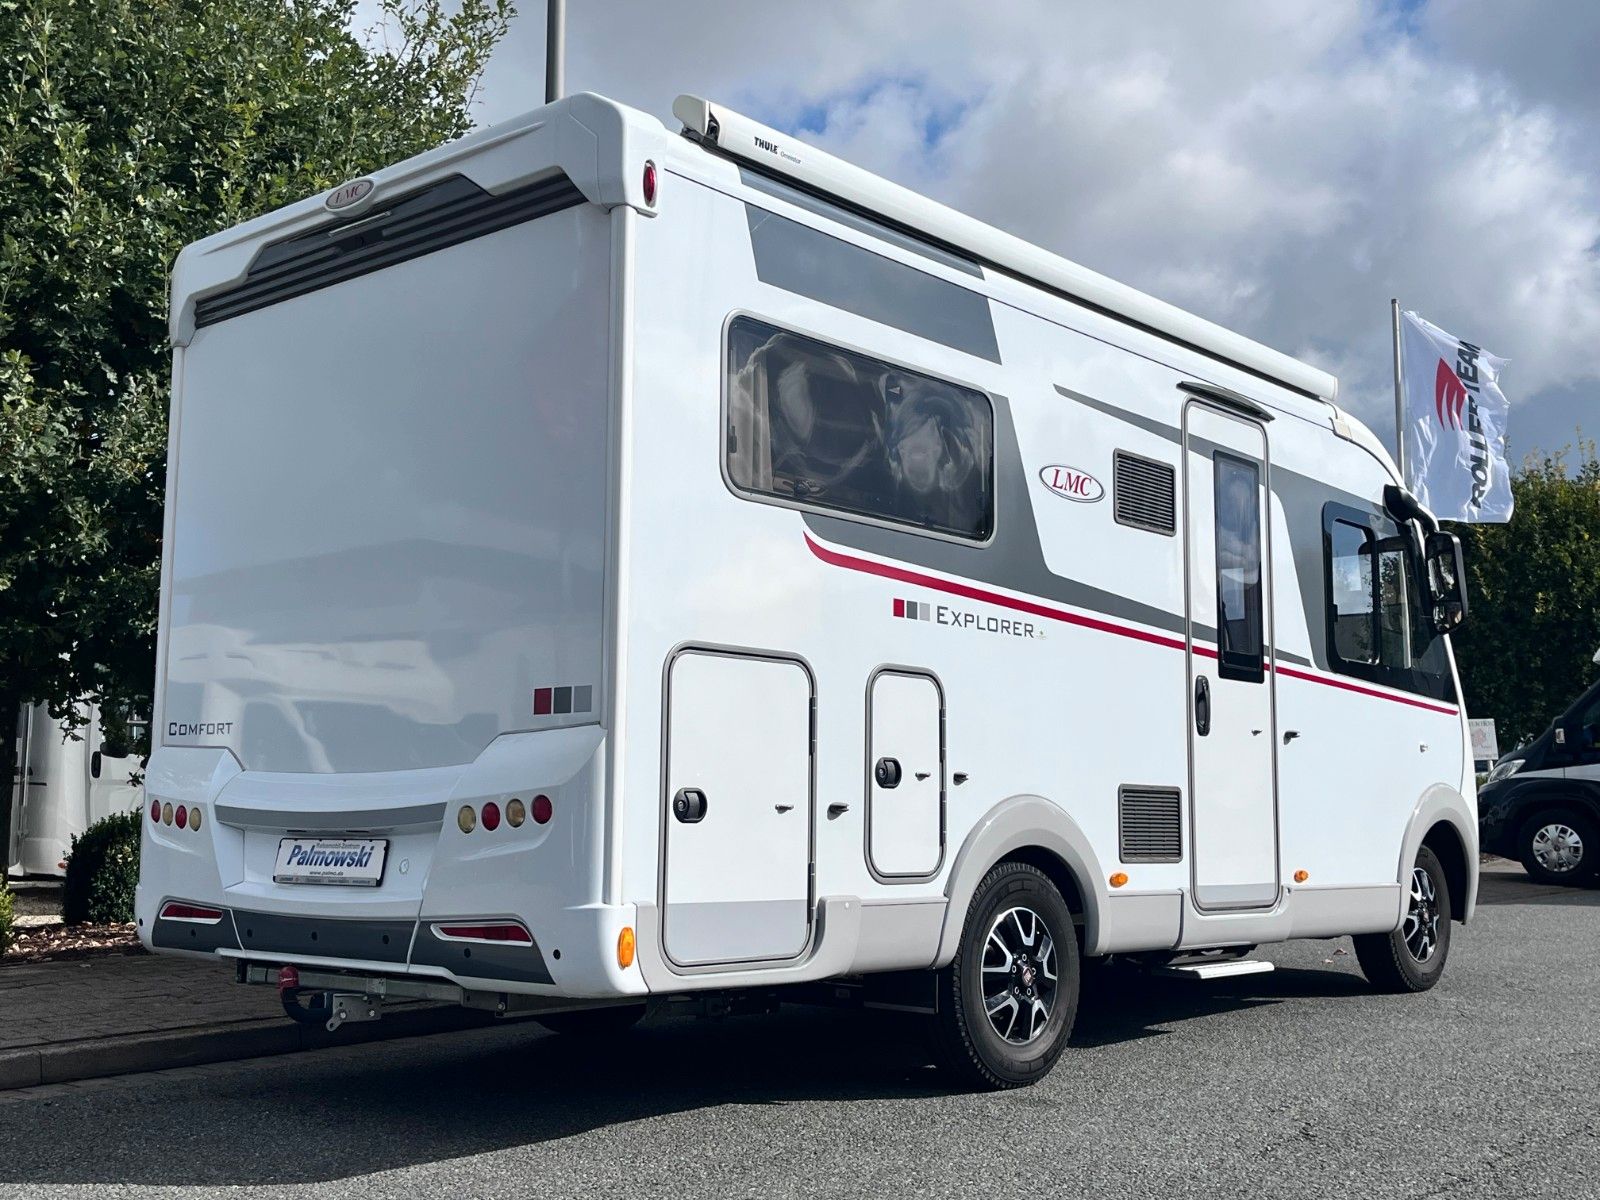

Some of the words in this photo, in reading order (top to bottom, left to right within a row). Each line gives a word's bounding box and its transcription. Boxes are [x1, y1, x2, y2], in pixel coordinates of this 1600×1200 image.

[754, 136, 778, 155] THULE
[334, 183, 364, 204] LMC
[1052, 468, 1092, 497] LMC
[936, 605, 1035, 639] EXPLORER
[168, 722, 234, 736] COMFORT
[286, 844, 375, 868] Palmowski
